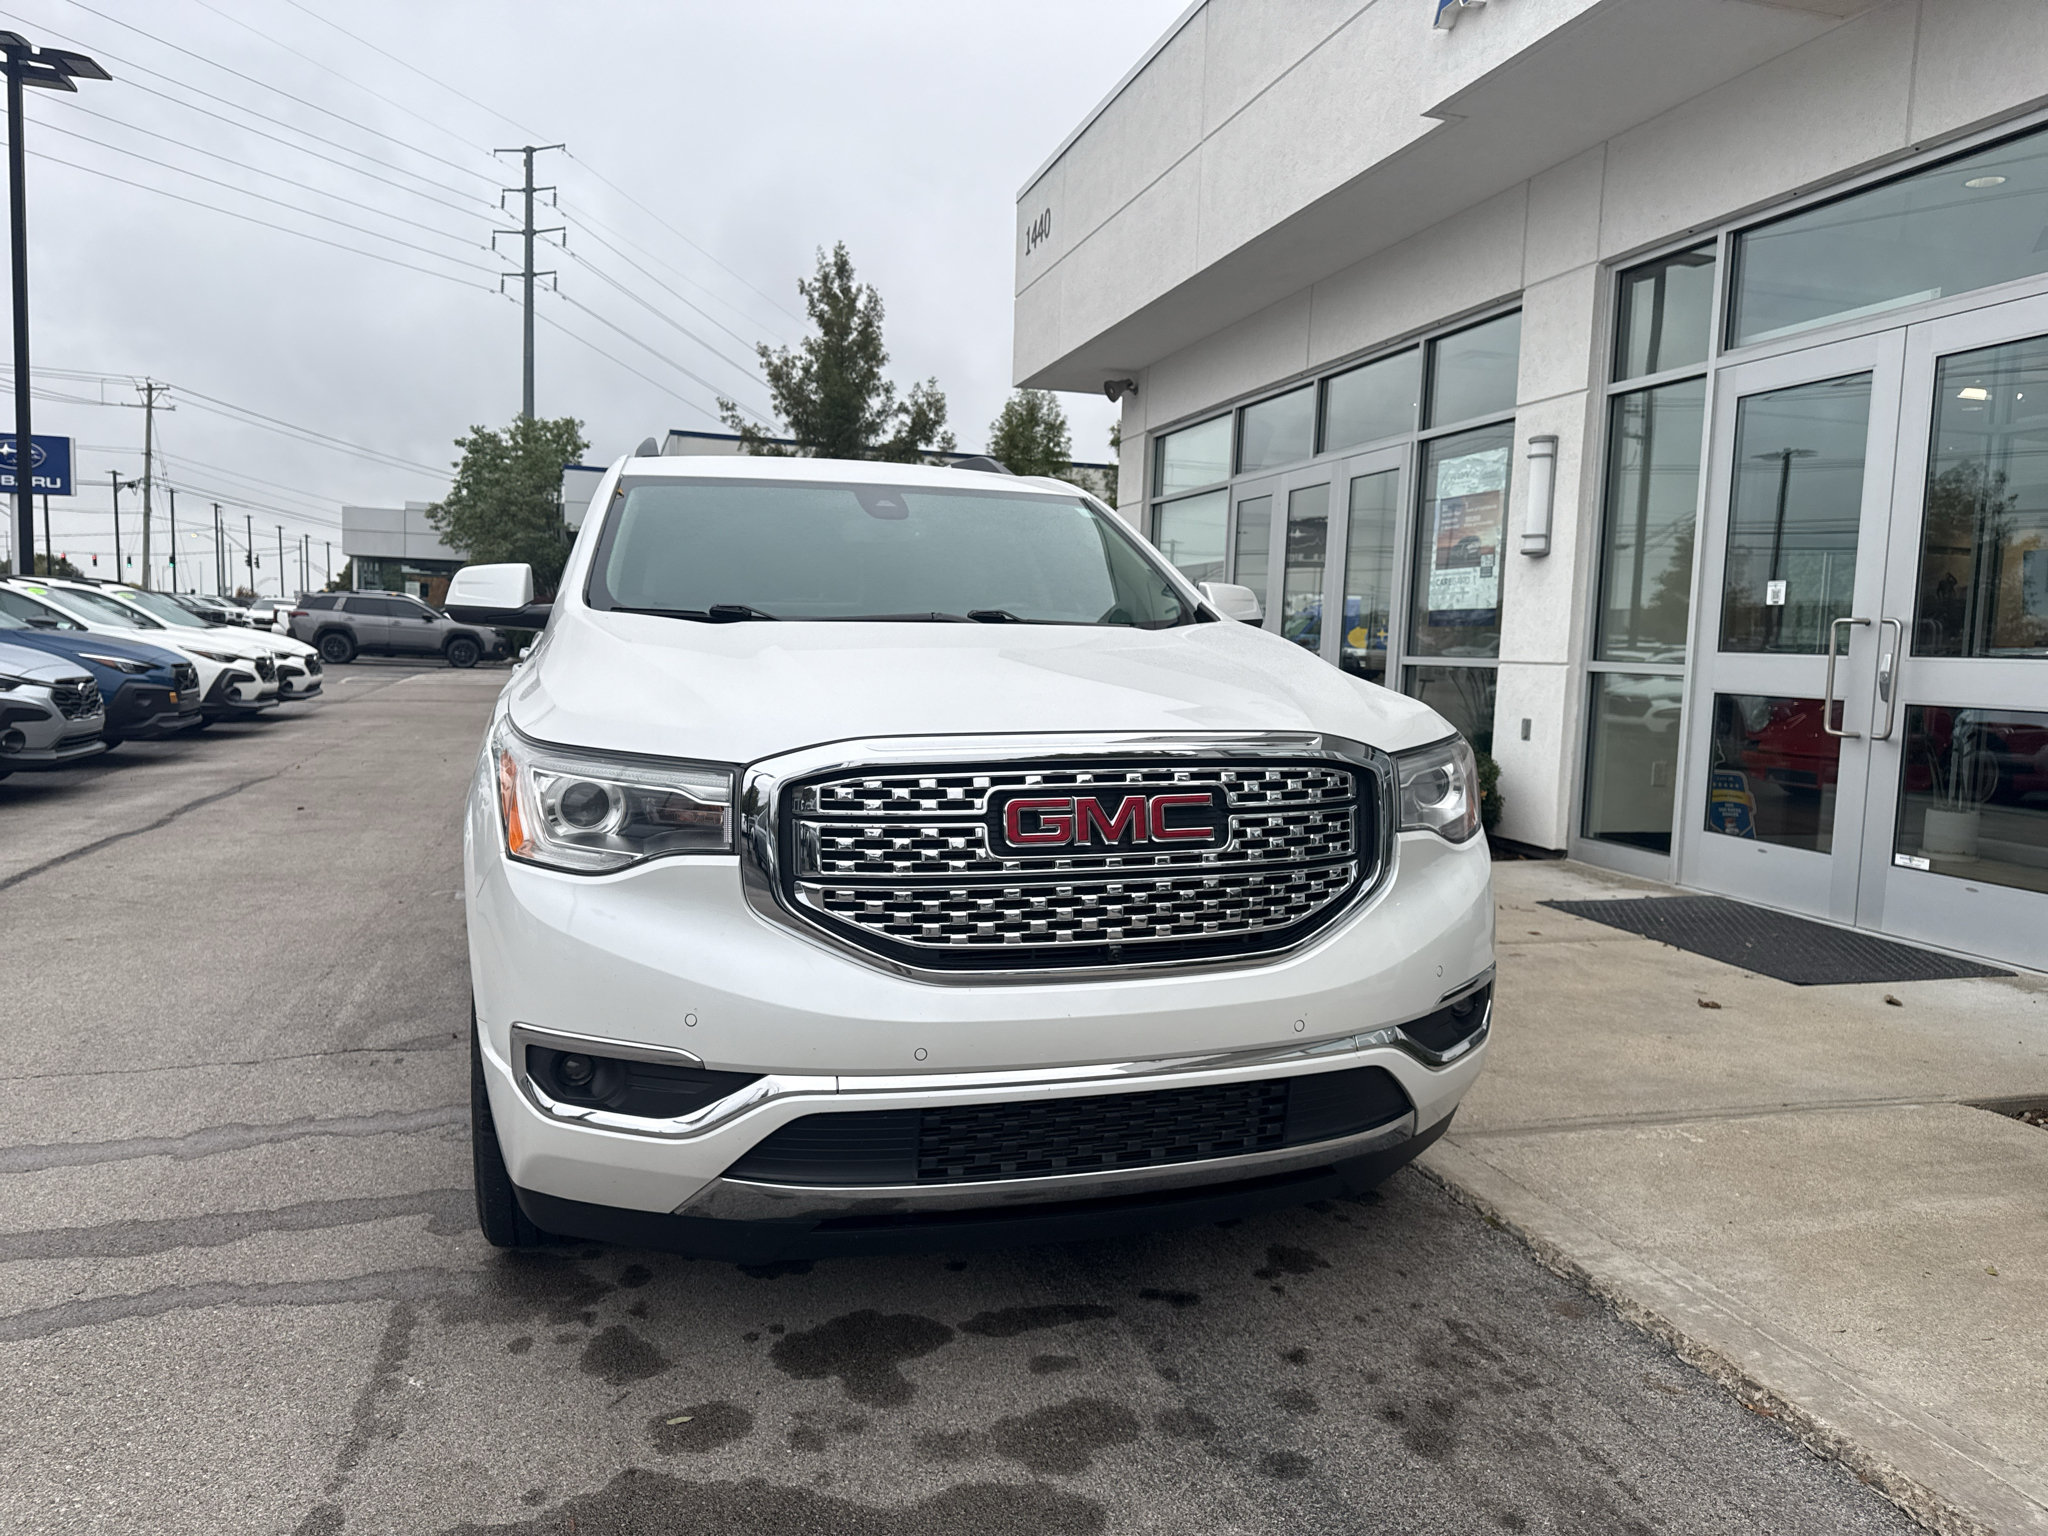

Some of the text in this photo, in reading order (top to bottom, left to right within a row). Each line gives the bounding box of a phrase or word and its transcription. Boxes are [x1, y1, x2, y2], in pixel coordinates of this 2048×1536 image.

[1026, 208, 1051, 256] 1440
[1, 474, 61, 489] BRU
[1003, 794, 1215, 848] GMC
